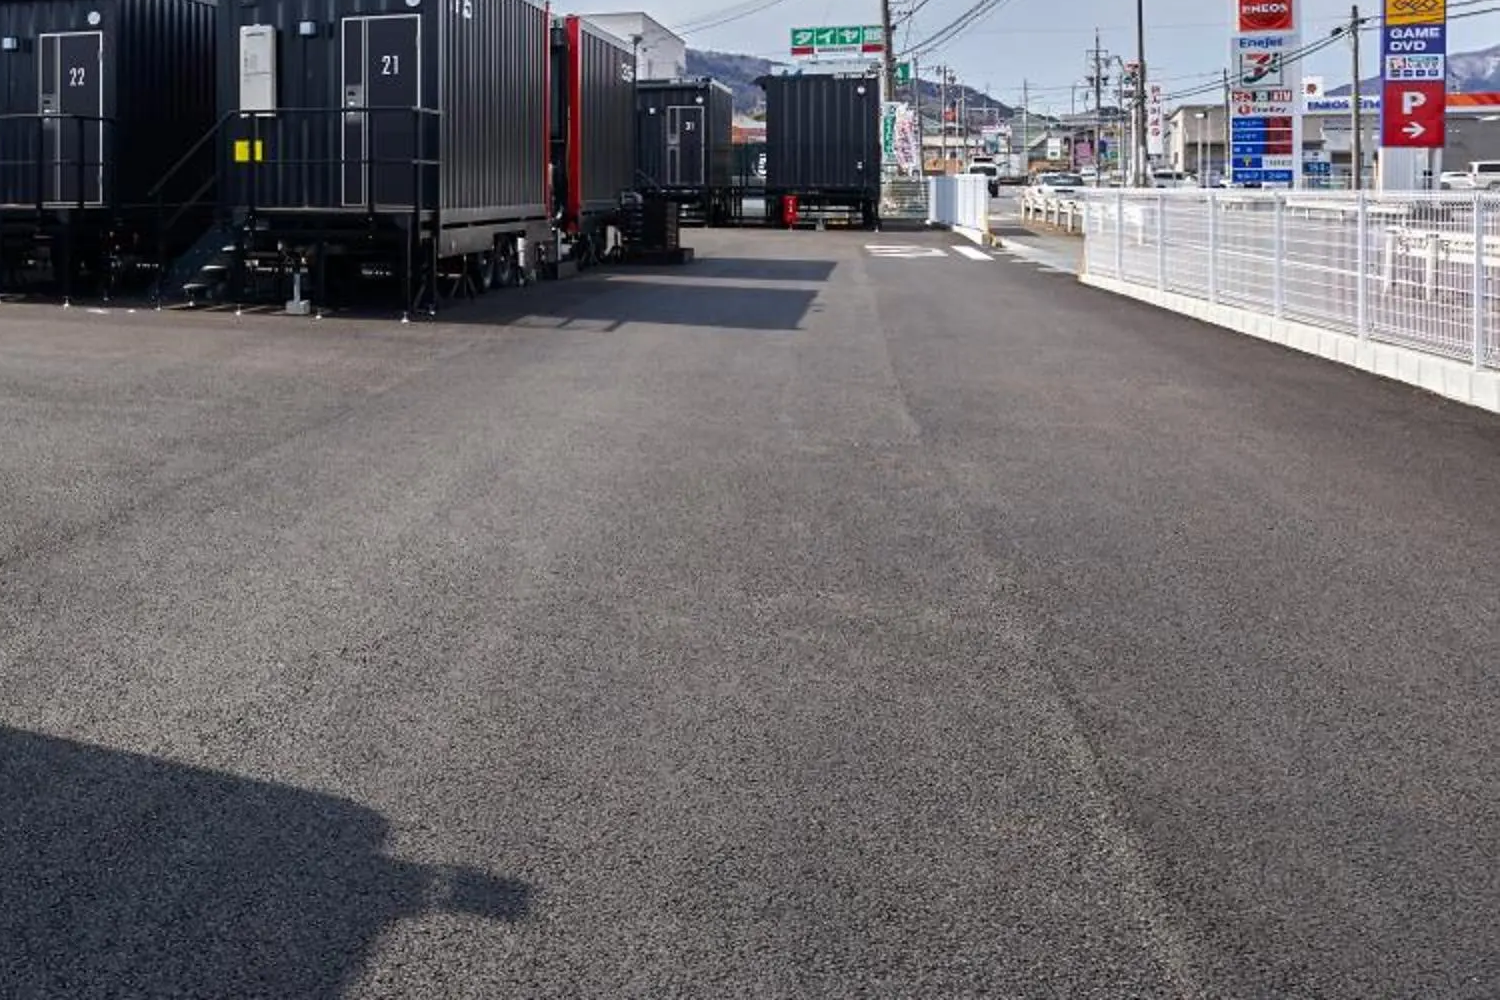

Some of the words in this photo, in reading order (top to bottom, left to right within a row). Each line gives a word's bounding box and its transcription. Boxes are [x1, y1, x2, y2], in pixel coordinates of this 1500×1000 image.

[1242, 3, 1288, 14] ENEOS
[1389, 27, 1441, 39] GAME
[1389, 40, 1427, 51] DVD
[381, 55, 399, 75] 21
[69, 67, 85, 87] 22
[1402, 92, 1427, 115] P
